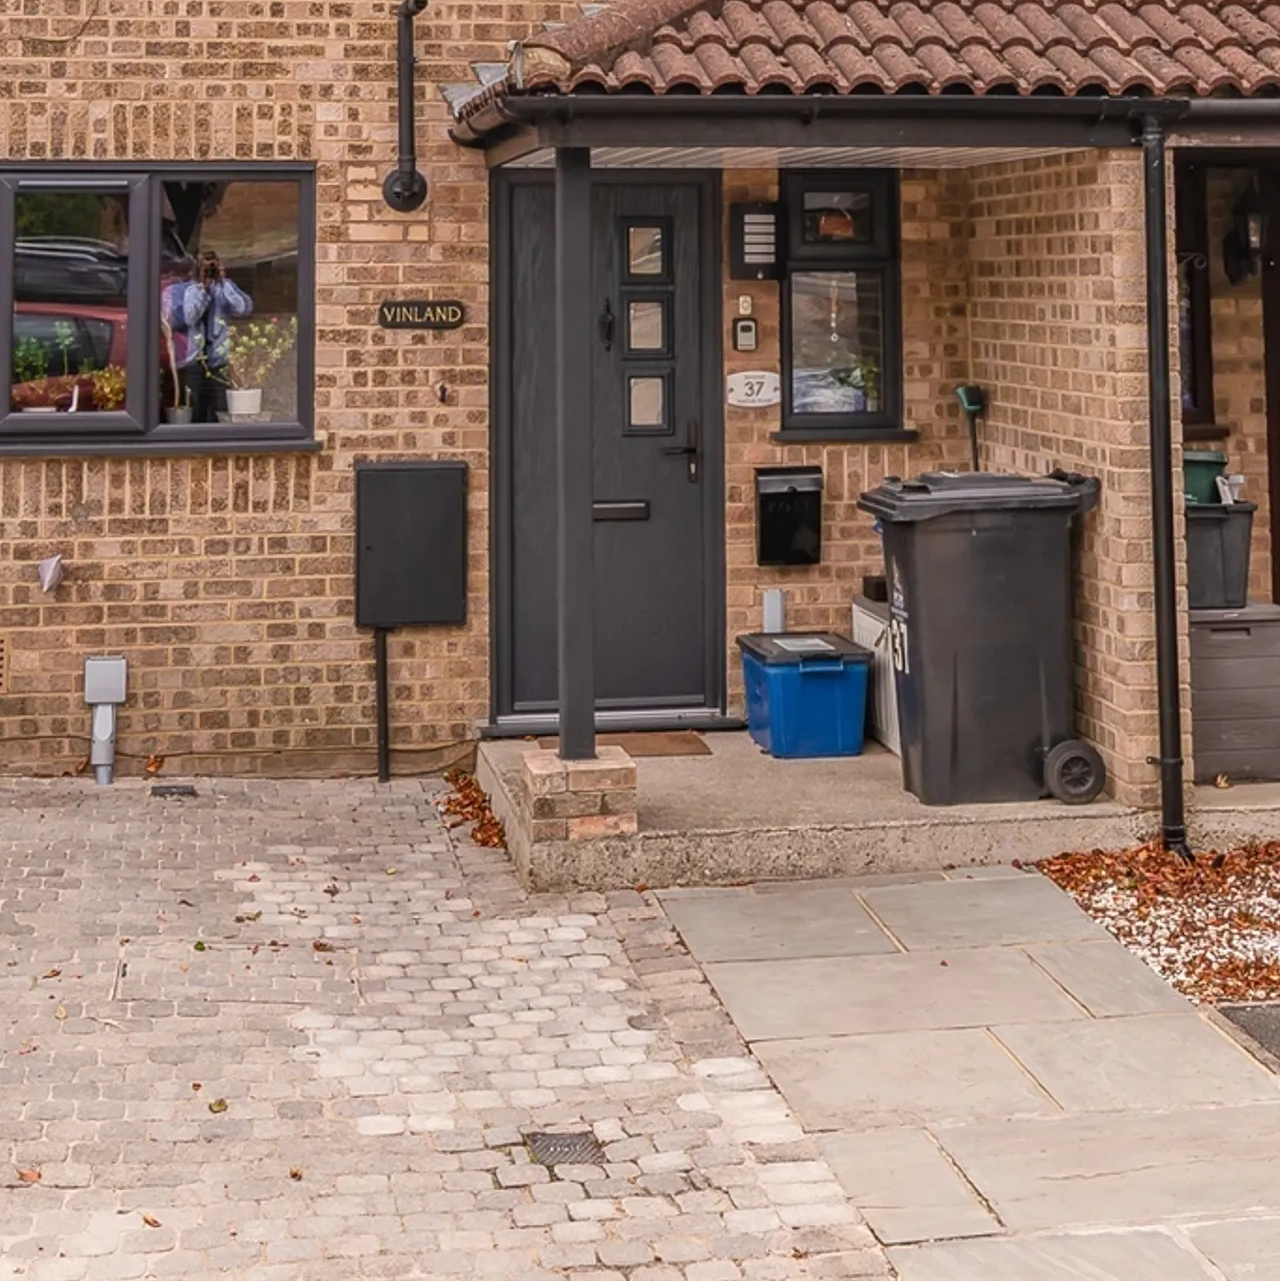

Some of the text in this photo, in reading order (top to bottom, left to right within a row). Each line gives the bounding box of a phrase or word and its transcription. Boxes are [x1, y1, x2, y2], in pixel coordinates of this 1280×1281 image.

[382, 305, 462, 323] VINLAND
[744, 381, 765, 398] 37
[891, 619, 910, 674] 37
